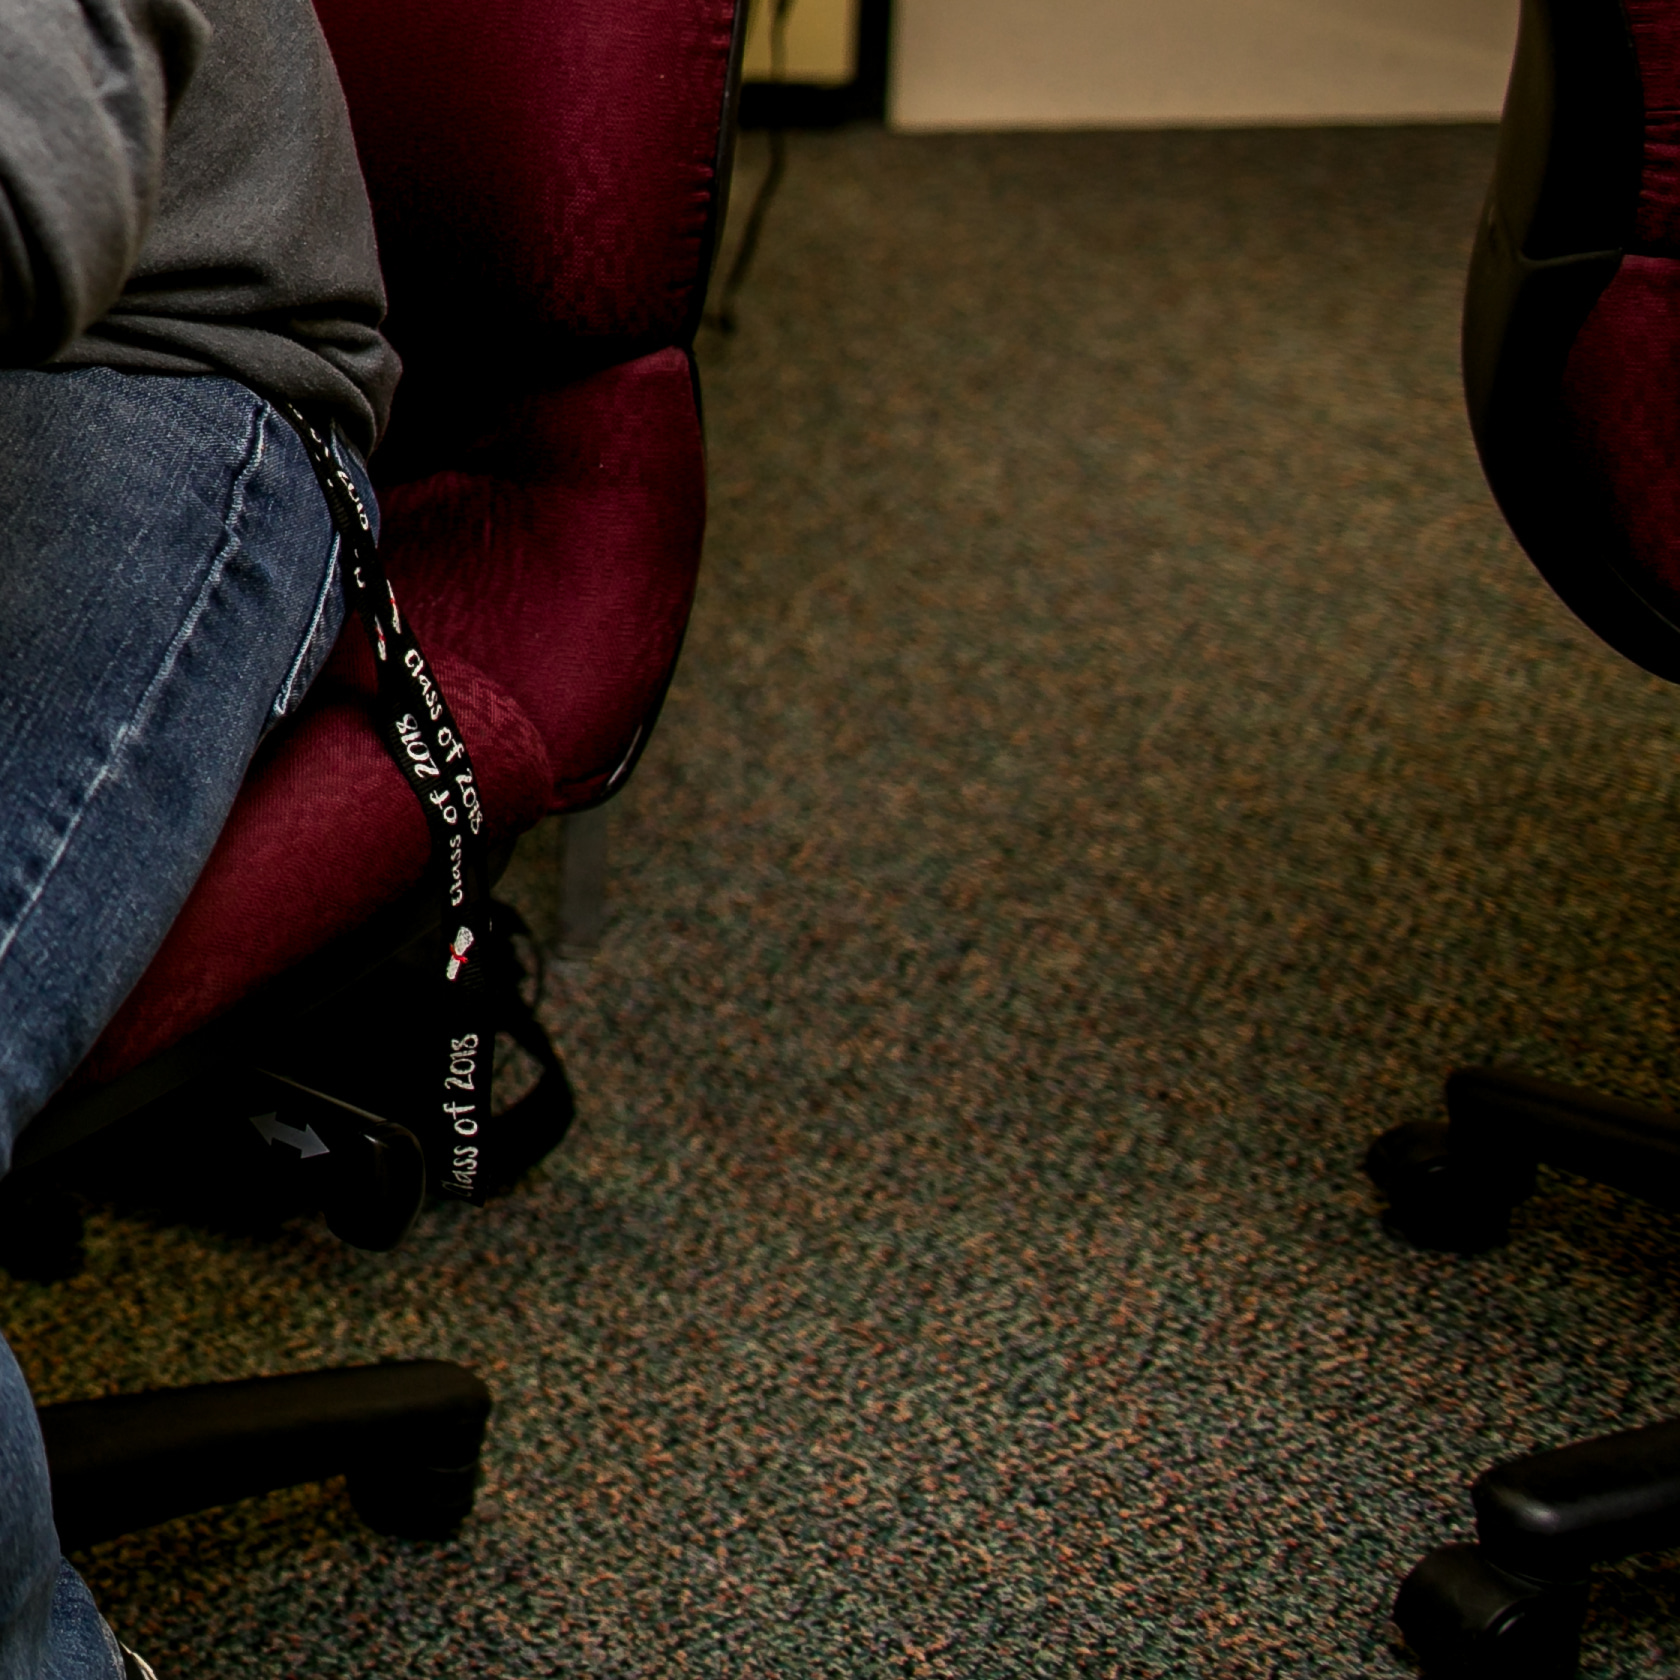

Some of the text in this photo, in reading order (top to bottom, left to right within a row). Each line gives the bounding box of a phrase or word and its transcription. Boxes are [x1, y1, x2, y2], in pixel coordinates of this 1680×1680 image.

[395, 713, 440, 779] 2018
[429, 789, 458, 824] of
[438, 726, 465, 763] of
[455, 767, 483, 835] 2018
[444, 1033, 479, 1090] 2018
[442, 1101, 479, 1136] of
